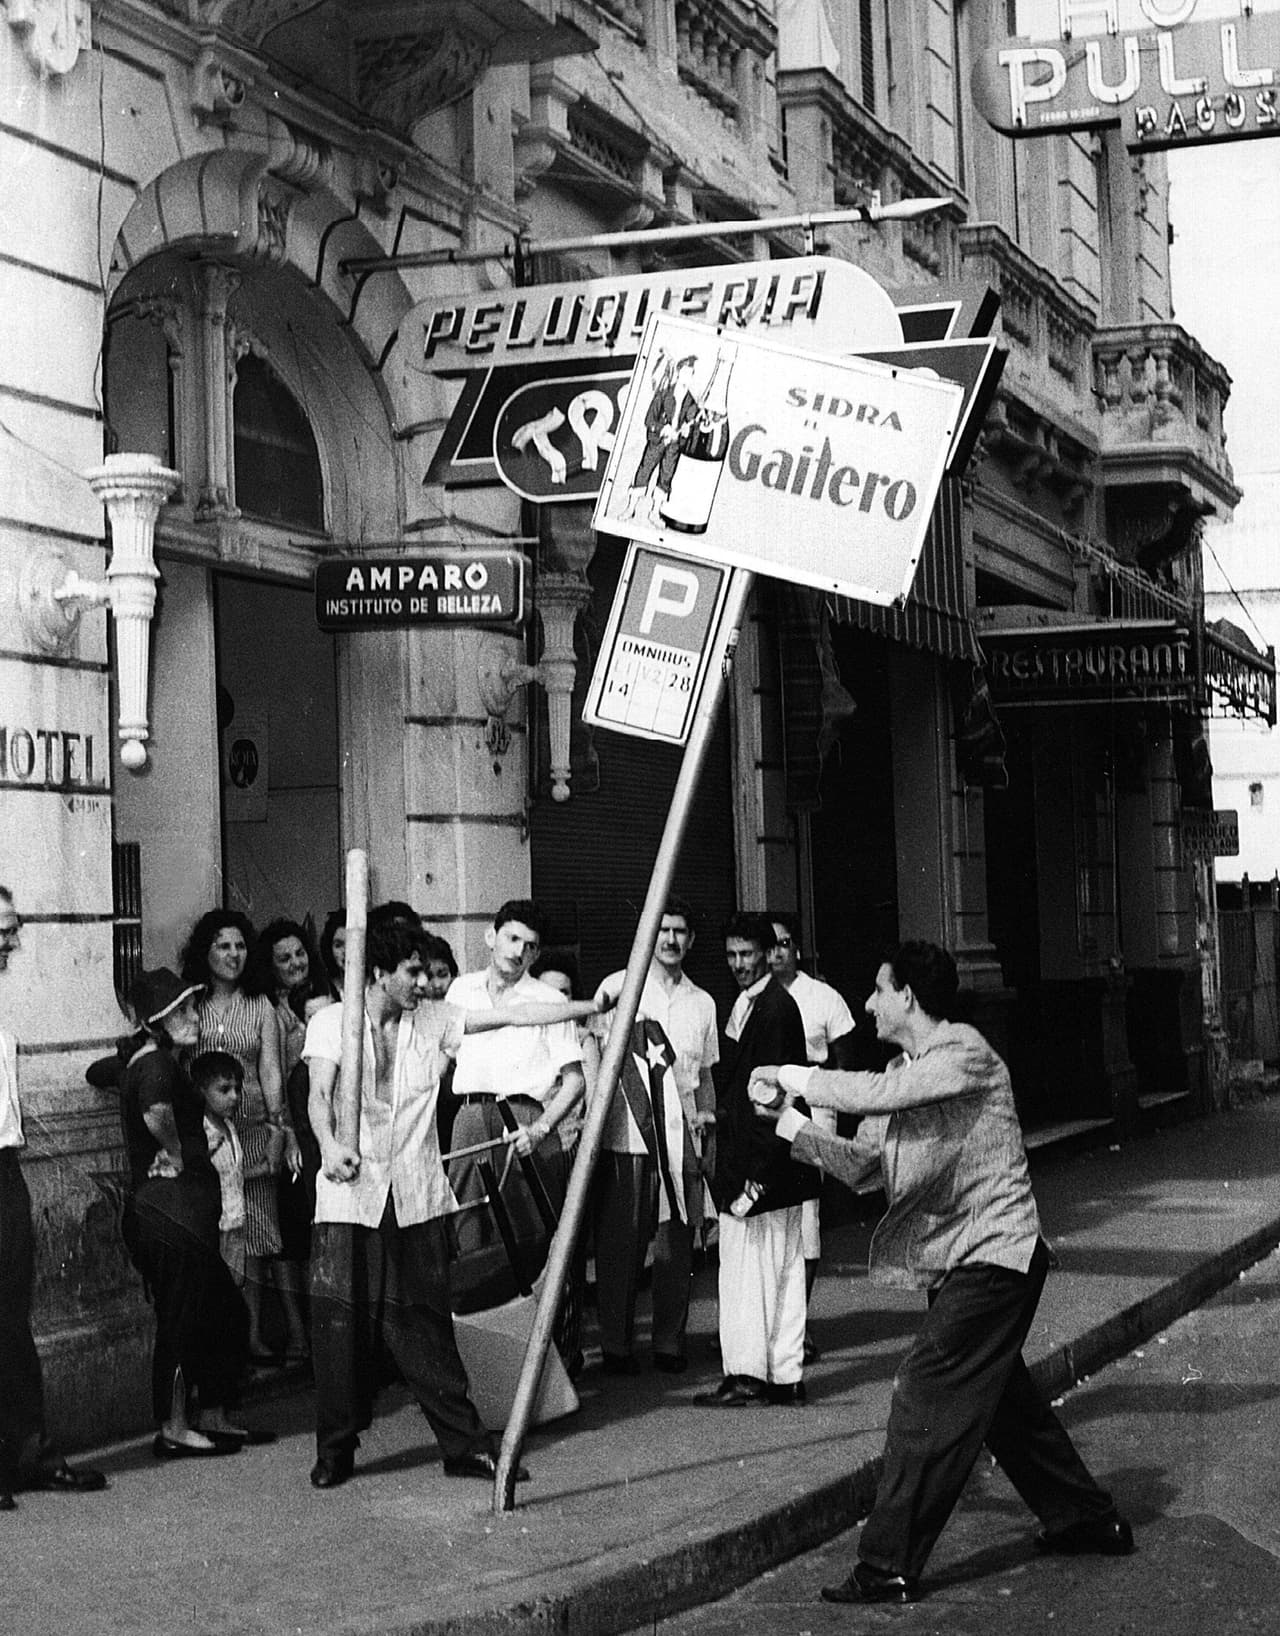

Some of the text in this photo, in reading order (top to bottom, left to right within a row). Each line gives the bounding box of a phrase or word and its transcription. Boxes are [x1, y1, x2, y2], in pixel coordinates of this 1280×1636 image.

[786, 387, 902, 432] SIDRA
[729, 424, 916, 521] Gaitero
[346, 561, 488, 591] AMPARO
[326, 594, 502, 615] INSTITUTO DE BELLEZA
[639, 563, 699, 635] P
[608, 680, 629, 697] 14
[669, 673, 691, 693] 28
